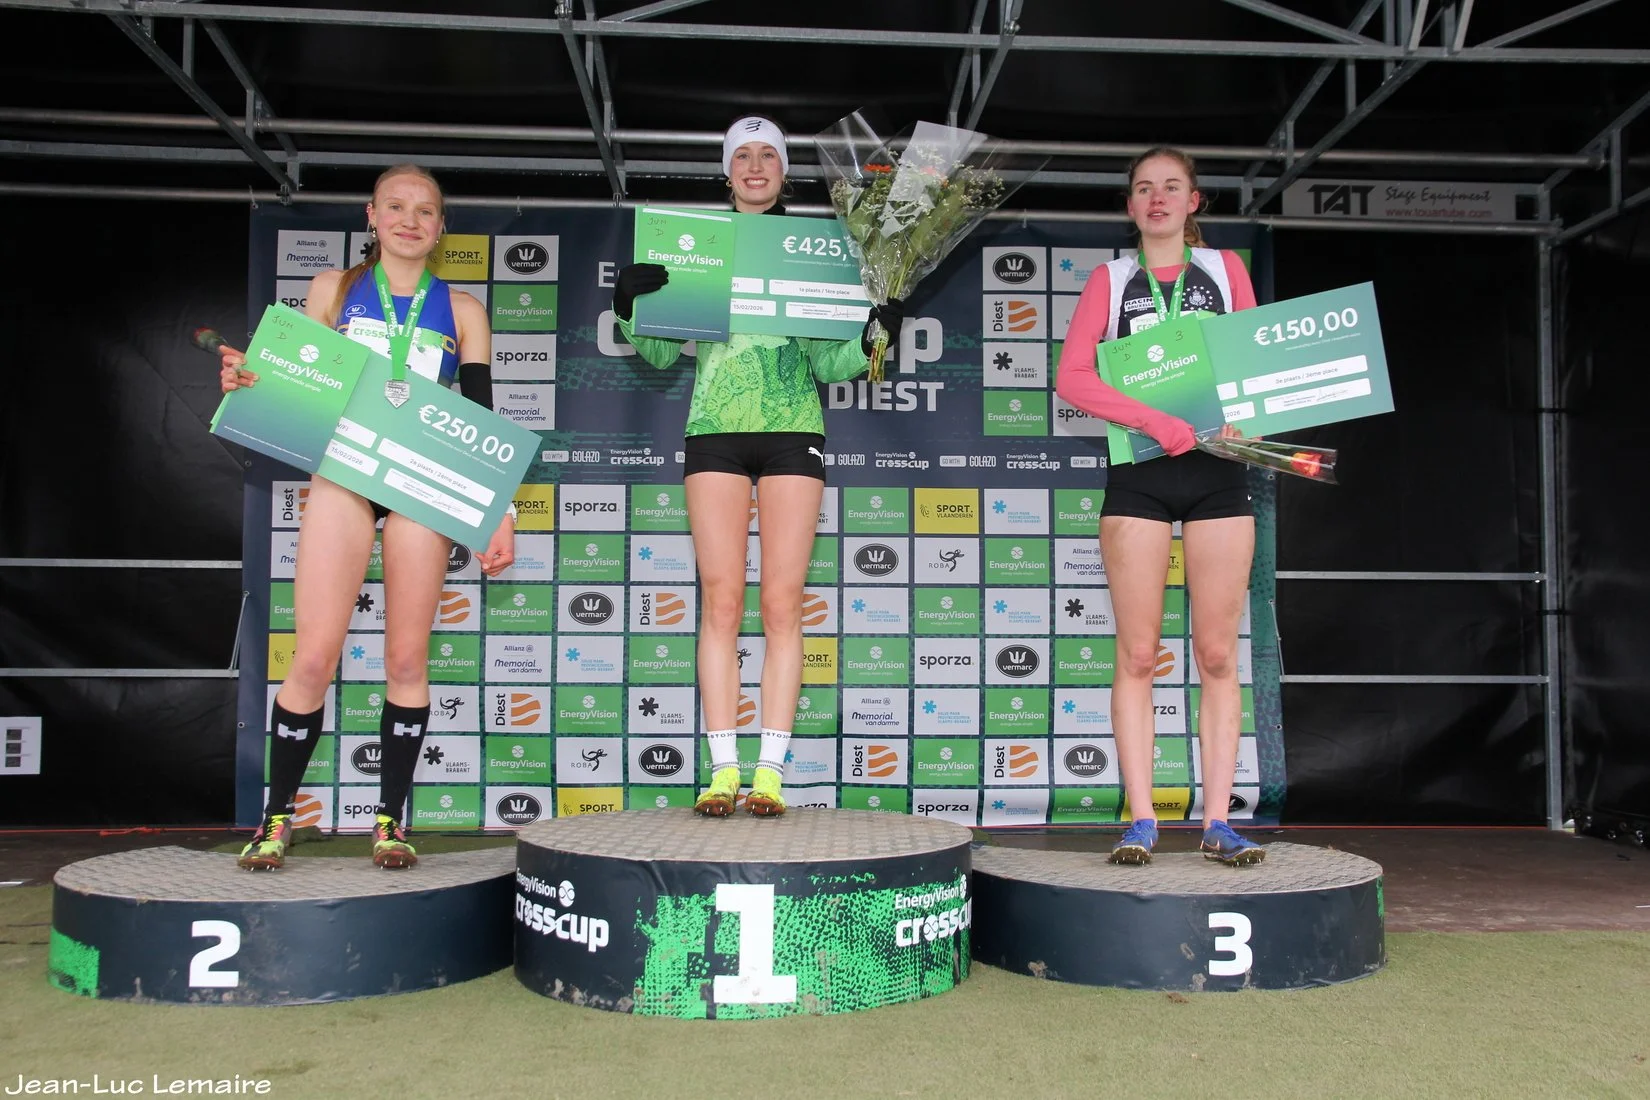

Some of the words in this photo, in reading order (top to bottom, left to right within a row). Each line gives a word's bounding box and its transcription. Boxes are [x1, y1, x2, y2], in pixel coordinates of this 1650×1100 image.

[1385, 186, 1417, 201] Stage
[1421, 187, 1492, 202] Equipment
[1308, 185, 1376, 216] TAT
[1385, 207, 1493, 218] www.touartube.com
[782, 236, 857, 261] €425,
[286, 253, 328, 262] Memorial
[445, 250, 482, 259] SPORT.
[648, 249, 724, 267] EnergyVision
[1125, 298, 1154, 306] RACIN
[496, 307, 553, 316] EnergyVision
[993, 301, 1004, 332] Diest
[1253, 307, 1358, 346] €150,00
[1176, 330, 1184, 342] 3
[260, 348, 344, 390] EnergyVision
[1122, 354, 1198, 386] EnergyVision
[829, 381, 945, 412] DIEST
[498, 407, 540, 416] Memorial
[988, 412, 1044, 422] EnergyVision
[418, 404, 515, 463] €250,00
[331, 446, 364, 466] 15/02/2026
[572, 450, 600, 462] GOLAZO
[838, 454, 866, 466] GOLAZO
[970, 456, 996, 468] GOLAZO
[282, 488, 294, 521] Diest
[936, 504, 974, 513] SPORT.
[635, 508, 688, 517] EnergyVisio
[848, 510, 904, 519] EnergyVision
[563, 558, 620, 567] EnergyVision
[989, 560, 1046, 570] EnergyVision
[1064, 562, 1103, 570] Memorial
[490, 608, 548, 617] EnergyVision
[576, 610, 606, 618] vermarc
[640, 592, 650, 626] Diest
[918, 610, 976, 620] EnergyVision
[427, 657, 475, 668] ergyVision
[494, 659, 536, 668] Memorial
[633, 660, 690, 669] EnergyVision
[848, 660, 904, 670] EnergyVision
[1059, 661, 1113, 670] EnergyVision
[496, 694, 506, 726] Diest
[560, 710, 618, 720] EnergyVision
[989, 711, 1044, 720] EnergyVision
[851, 712, 893, 720] Memorial
[490, 759, 546, 769] EnergyVision
[852, 746, 863, 777] Diest
[918, 762, 974, 771] EnergyVision
[994, 746, 1005, 778] Diest
[417, 809, 476, 819] EnergyVision
[516, 868, 556, 898] EnergyVision
[895, 884, 960, 909] EnergyVision
[516, 892, 610, 952] crosscup
[714, 884, 797, 1004] 1
[1208, 912, 1253, 976] 3
[188, 920, 241, 988] 2
